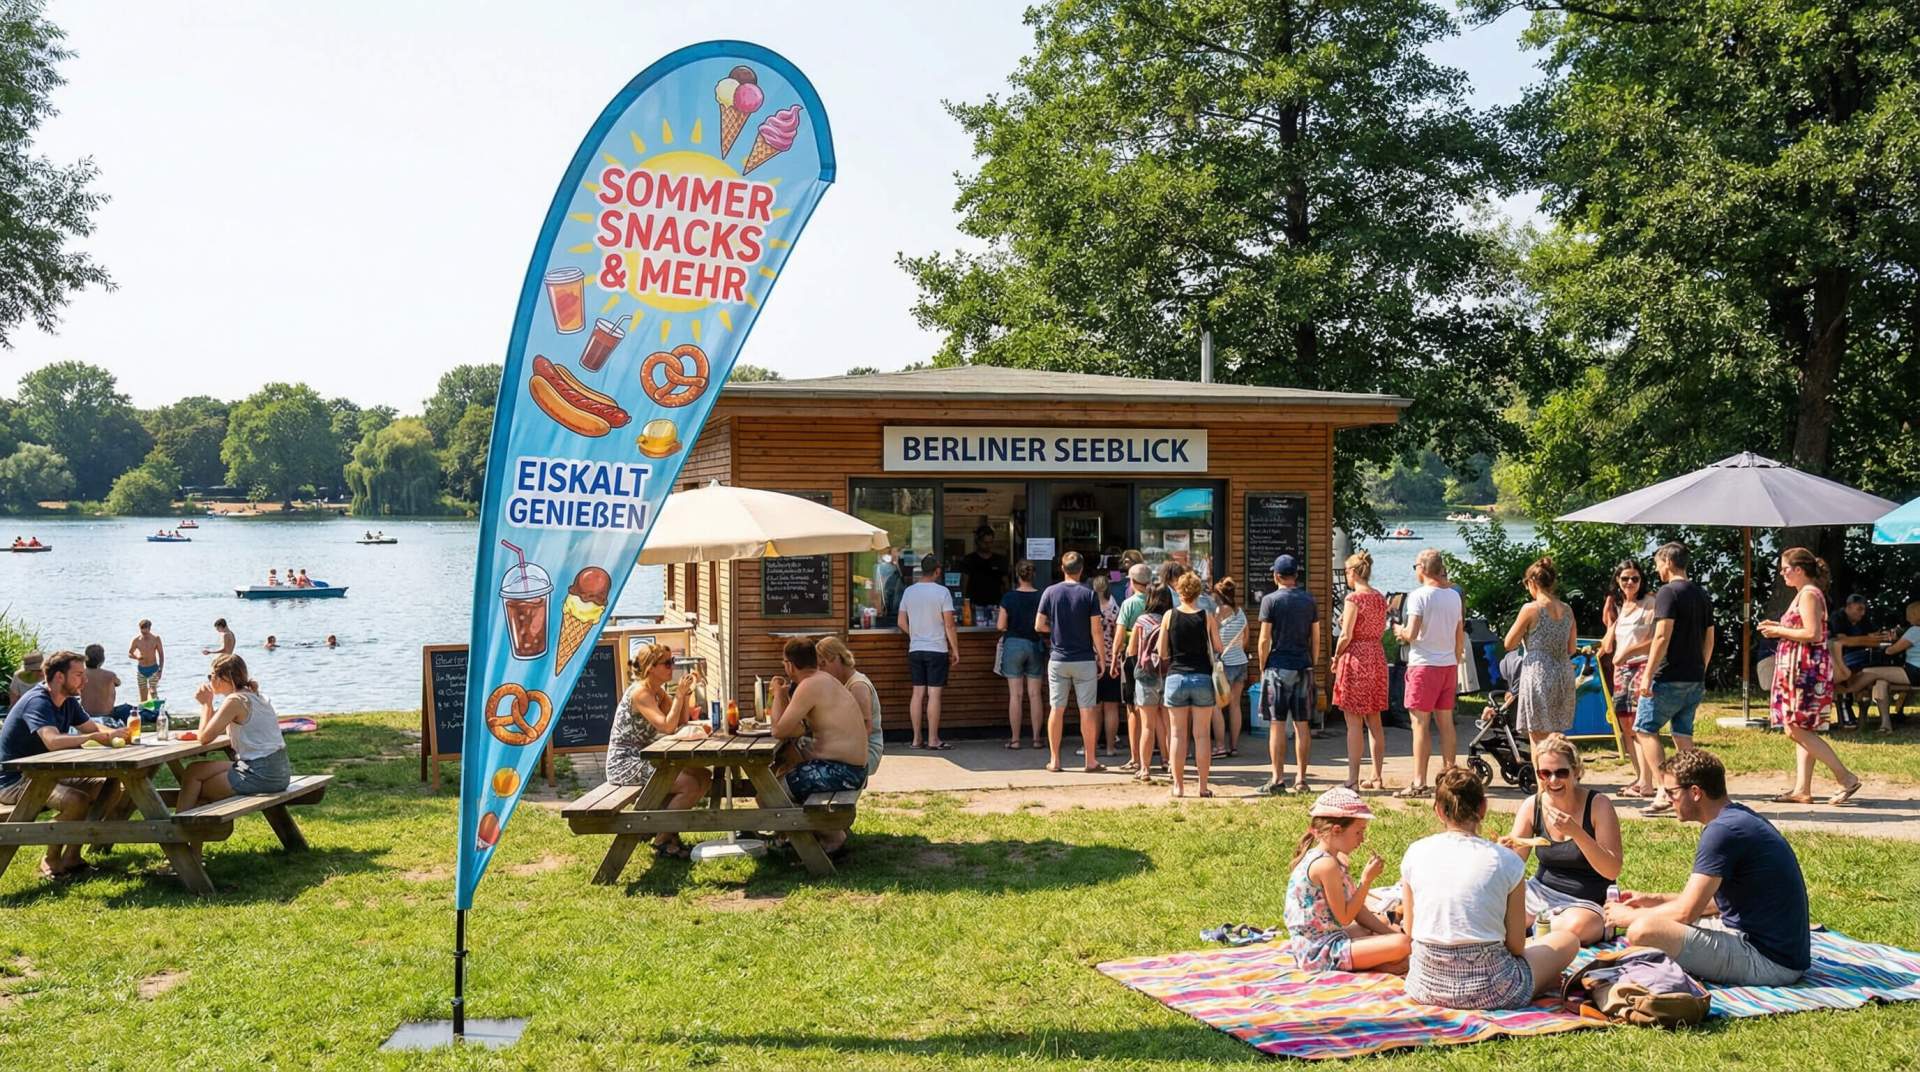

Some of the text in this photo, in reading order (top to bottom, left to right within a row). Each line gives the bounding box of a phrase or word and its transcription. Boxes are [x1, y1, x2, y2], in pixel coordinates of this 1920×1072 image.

[599, 168, 774, 221] SOMMER
[599, 210, 763, 263] SNACKS
[600, 253, 747, 301] & MEHR
[902, 437, 1190, 464] BERLINER SEEBLICK
[518, 460, 648, 498] EISKALT
[509, 497, 647, 530] GENIEßEN
